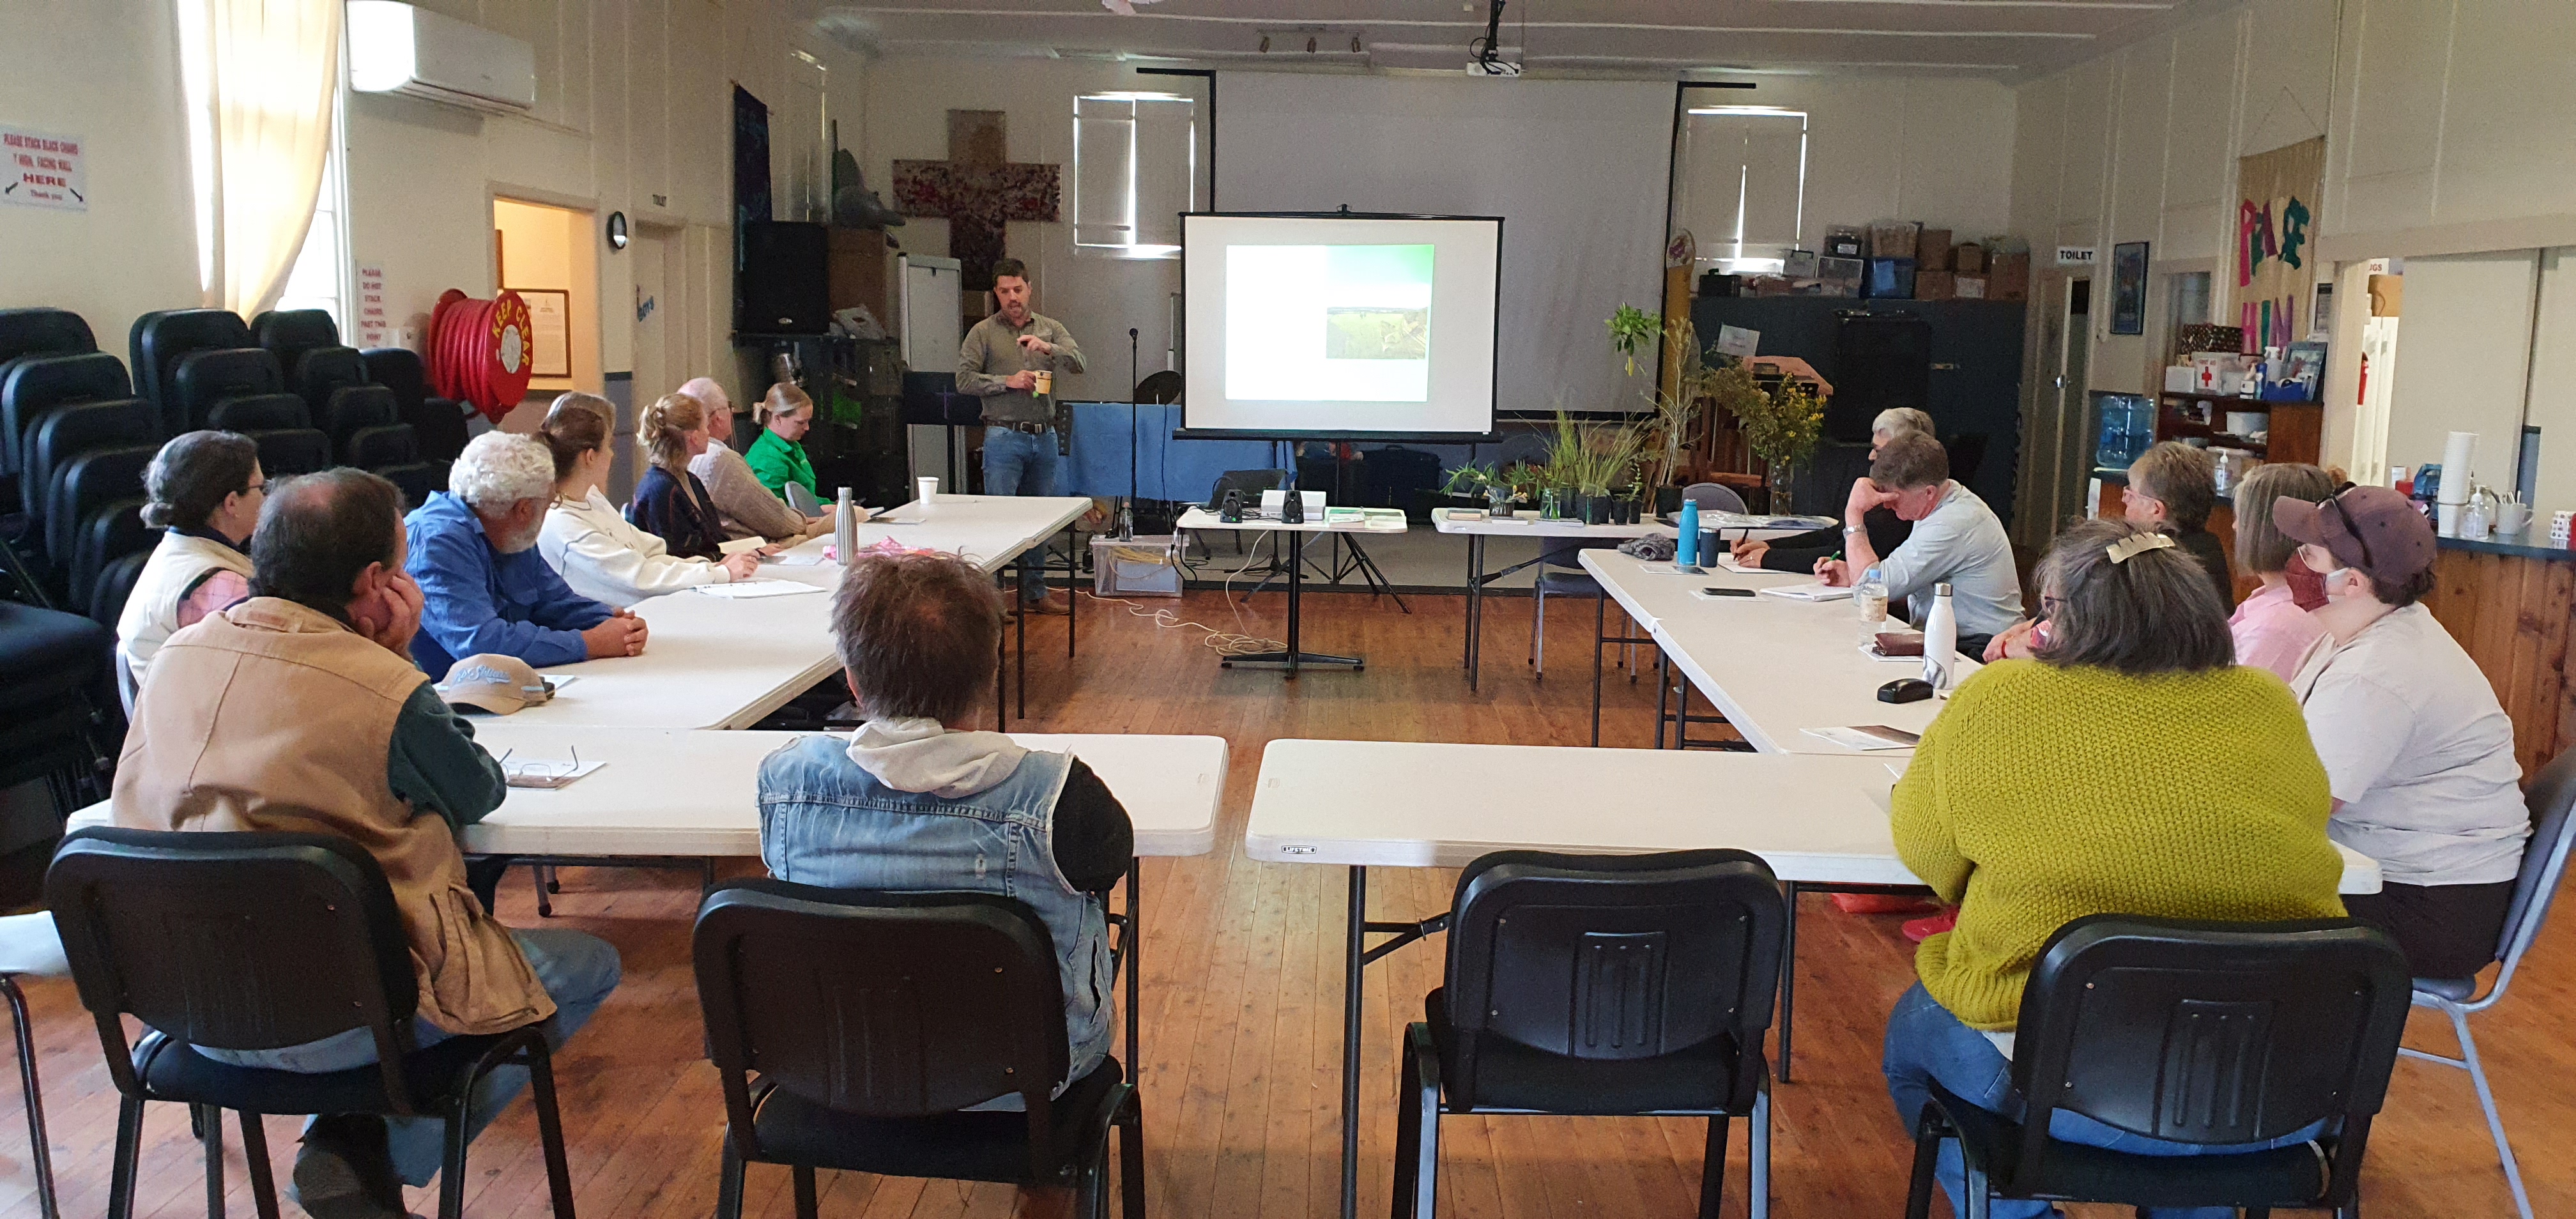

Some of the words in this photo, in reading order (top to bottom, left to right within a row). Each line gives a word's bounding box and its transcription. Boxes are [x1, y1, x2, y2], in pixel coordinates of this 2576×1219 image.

[4, 133, 24, 148] PLEASE
[24, 135, 41, 150] STACK
[23, 172, 66, 187] HERE
[2060, 250, 2093, 260] TOILET
[362, 268, 381, 277] PLEASE
[362, 282, 370, 290] DO
[491, 299, 512, 339] KEEP
[515, 305, 530, 366] CLEAR
